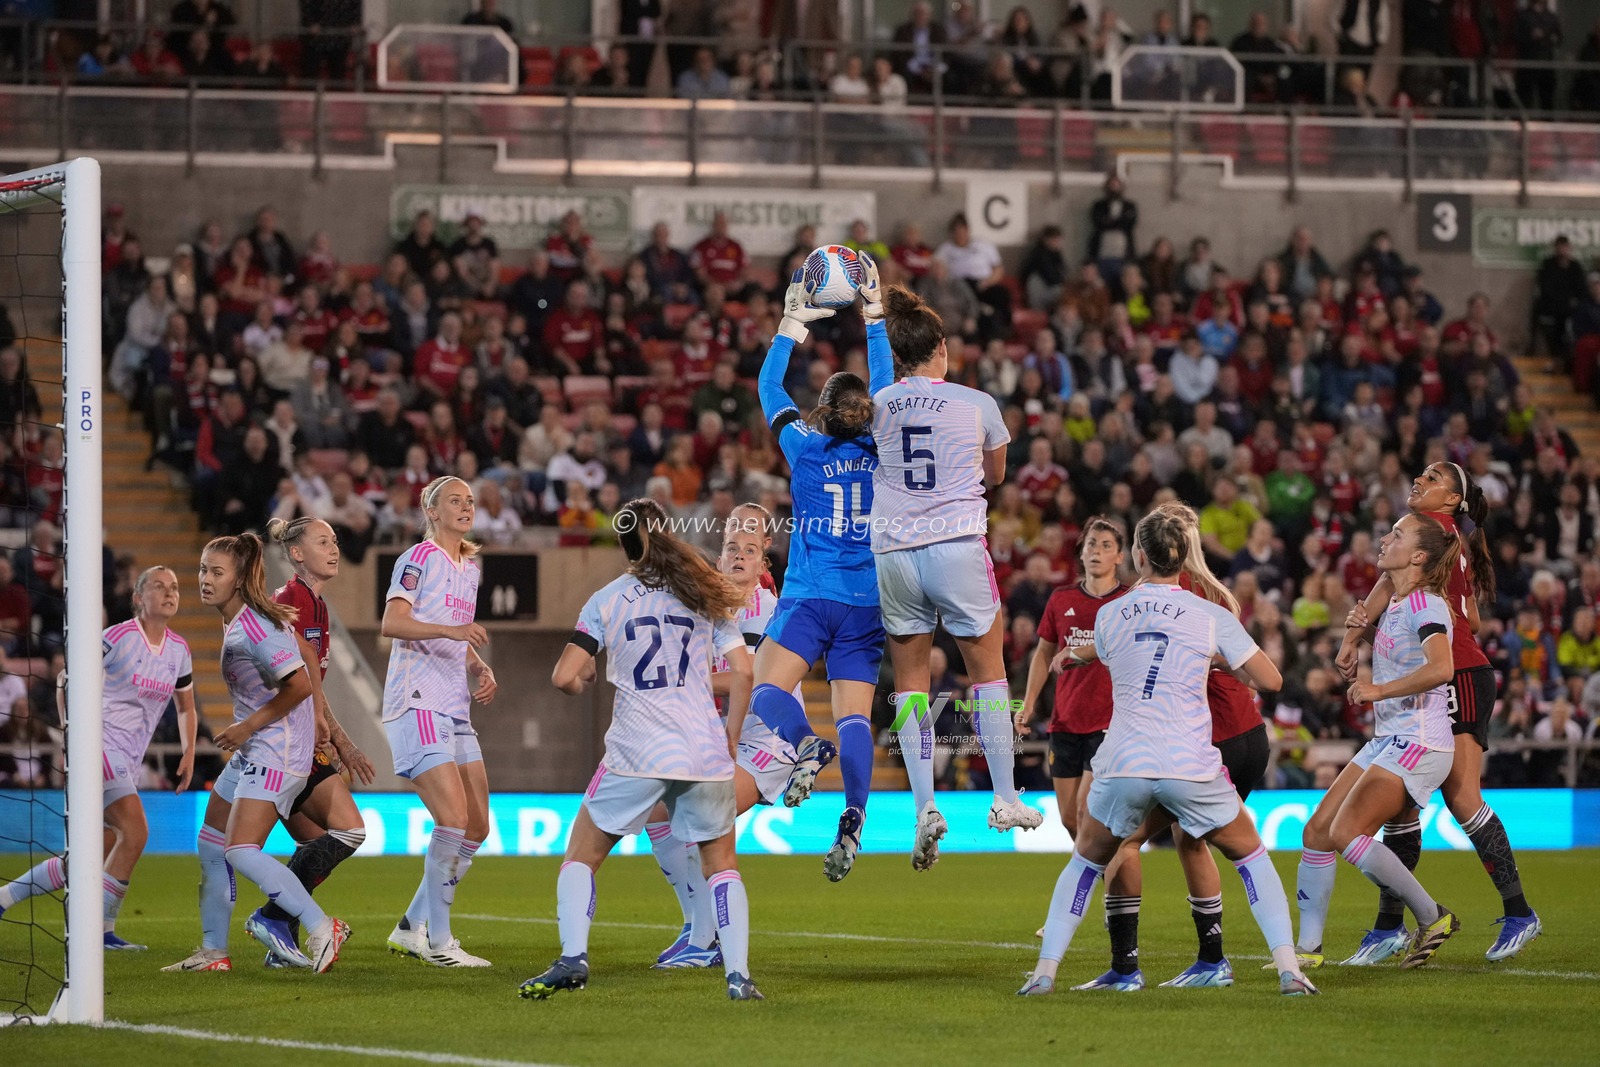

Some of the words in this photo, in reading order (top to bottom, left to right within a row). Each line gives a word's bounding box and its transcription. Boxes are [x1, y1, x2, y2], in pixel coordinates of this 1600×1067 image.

[984, 195, 1009, 230] C
[1432, 201, 1458, 242] 3
[81, 391, 93, 431] PRO
[887, 397, 948, 415] BEATTIE
[901, 426, 936, 490] 5
[1121, 601, 1186, 620] CATLEY
[624, 614, 695, 691] 27
[1134, 631, 1170, 701] 7
[717, 892, 728, 926] ARSENAL
